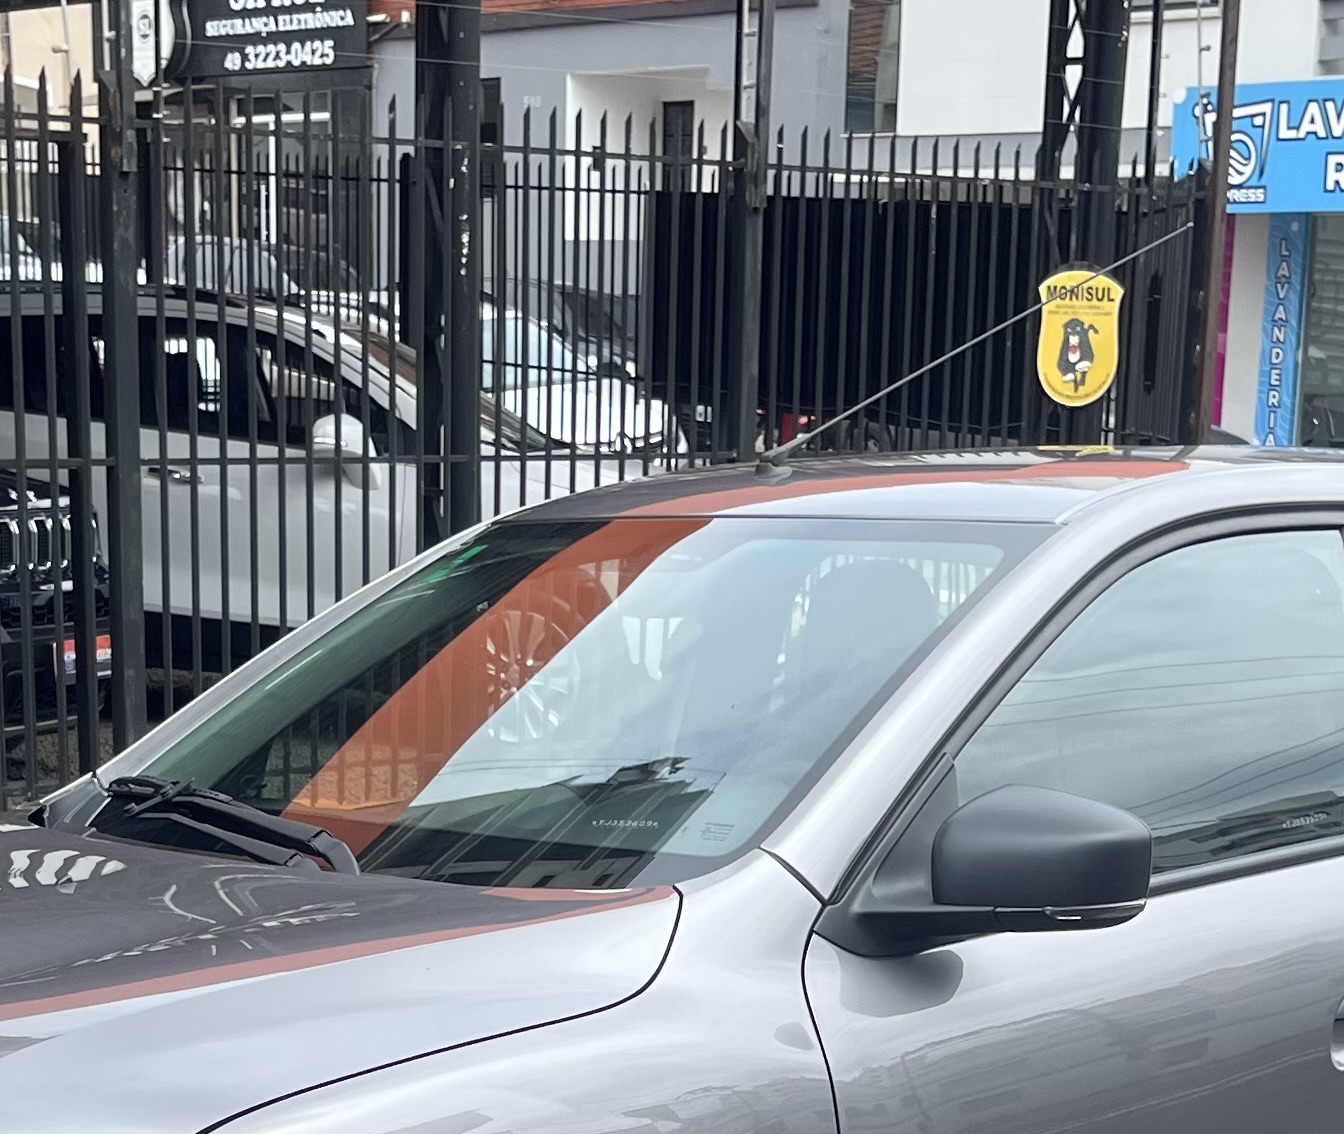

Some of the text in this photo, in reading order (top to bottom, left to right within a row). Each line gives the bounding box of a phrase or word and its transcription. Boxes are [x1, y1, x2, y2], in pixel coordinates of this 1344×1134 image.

[205, 6, 355, 37] SEGURANÇA ELETRÔNICA
[223, 40, 336, 71] 49 3223-0425
[1046, 286, 1115, 303] MONISUL
[1262, 237, 1292, 446] LAVANDERIA
